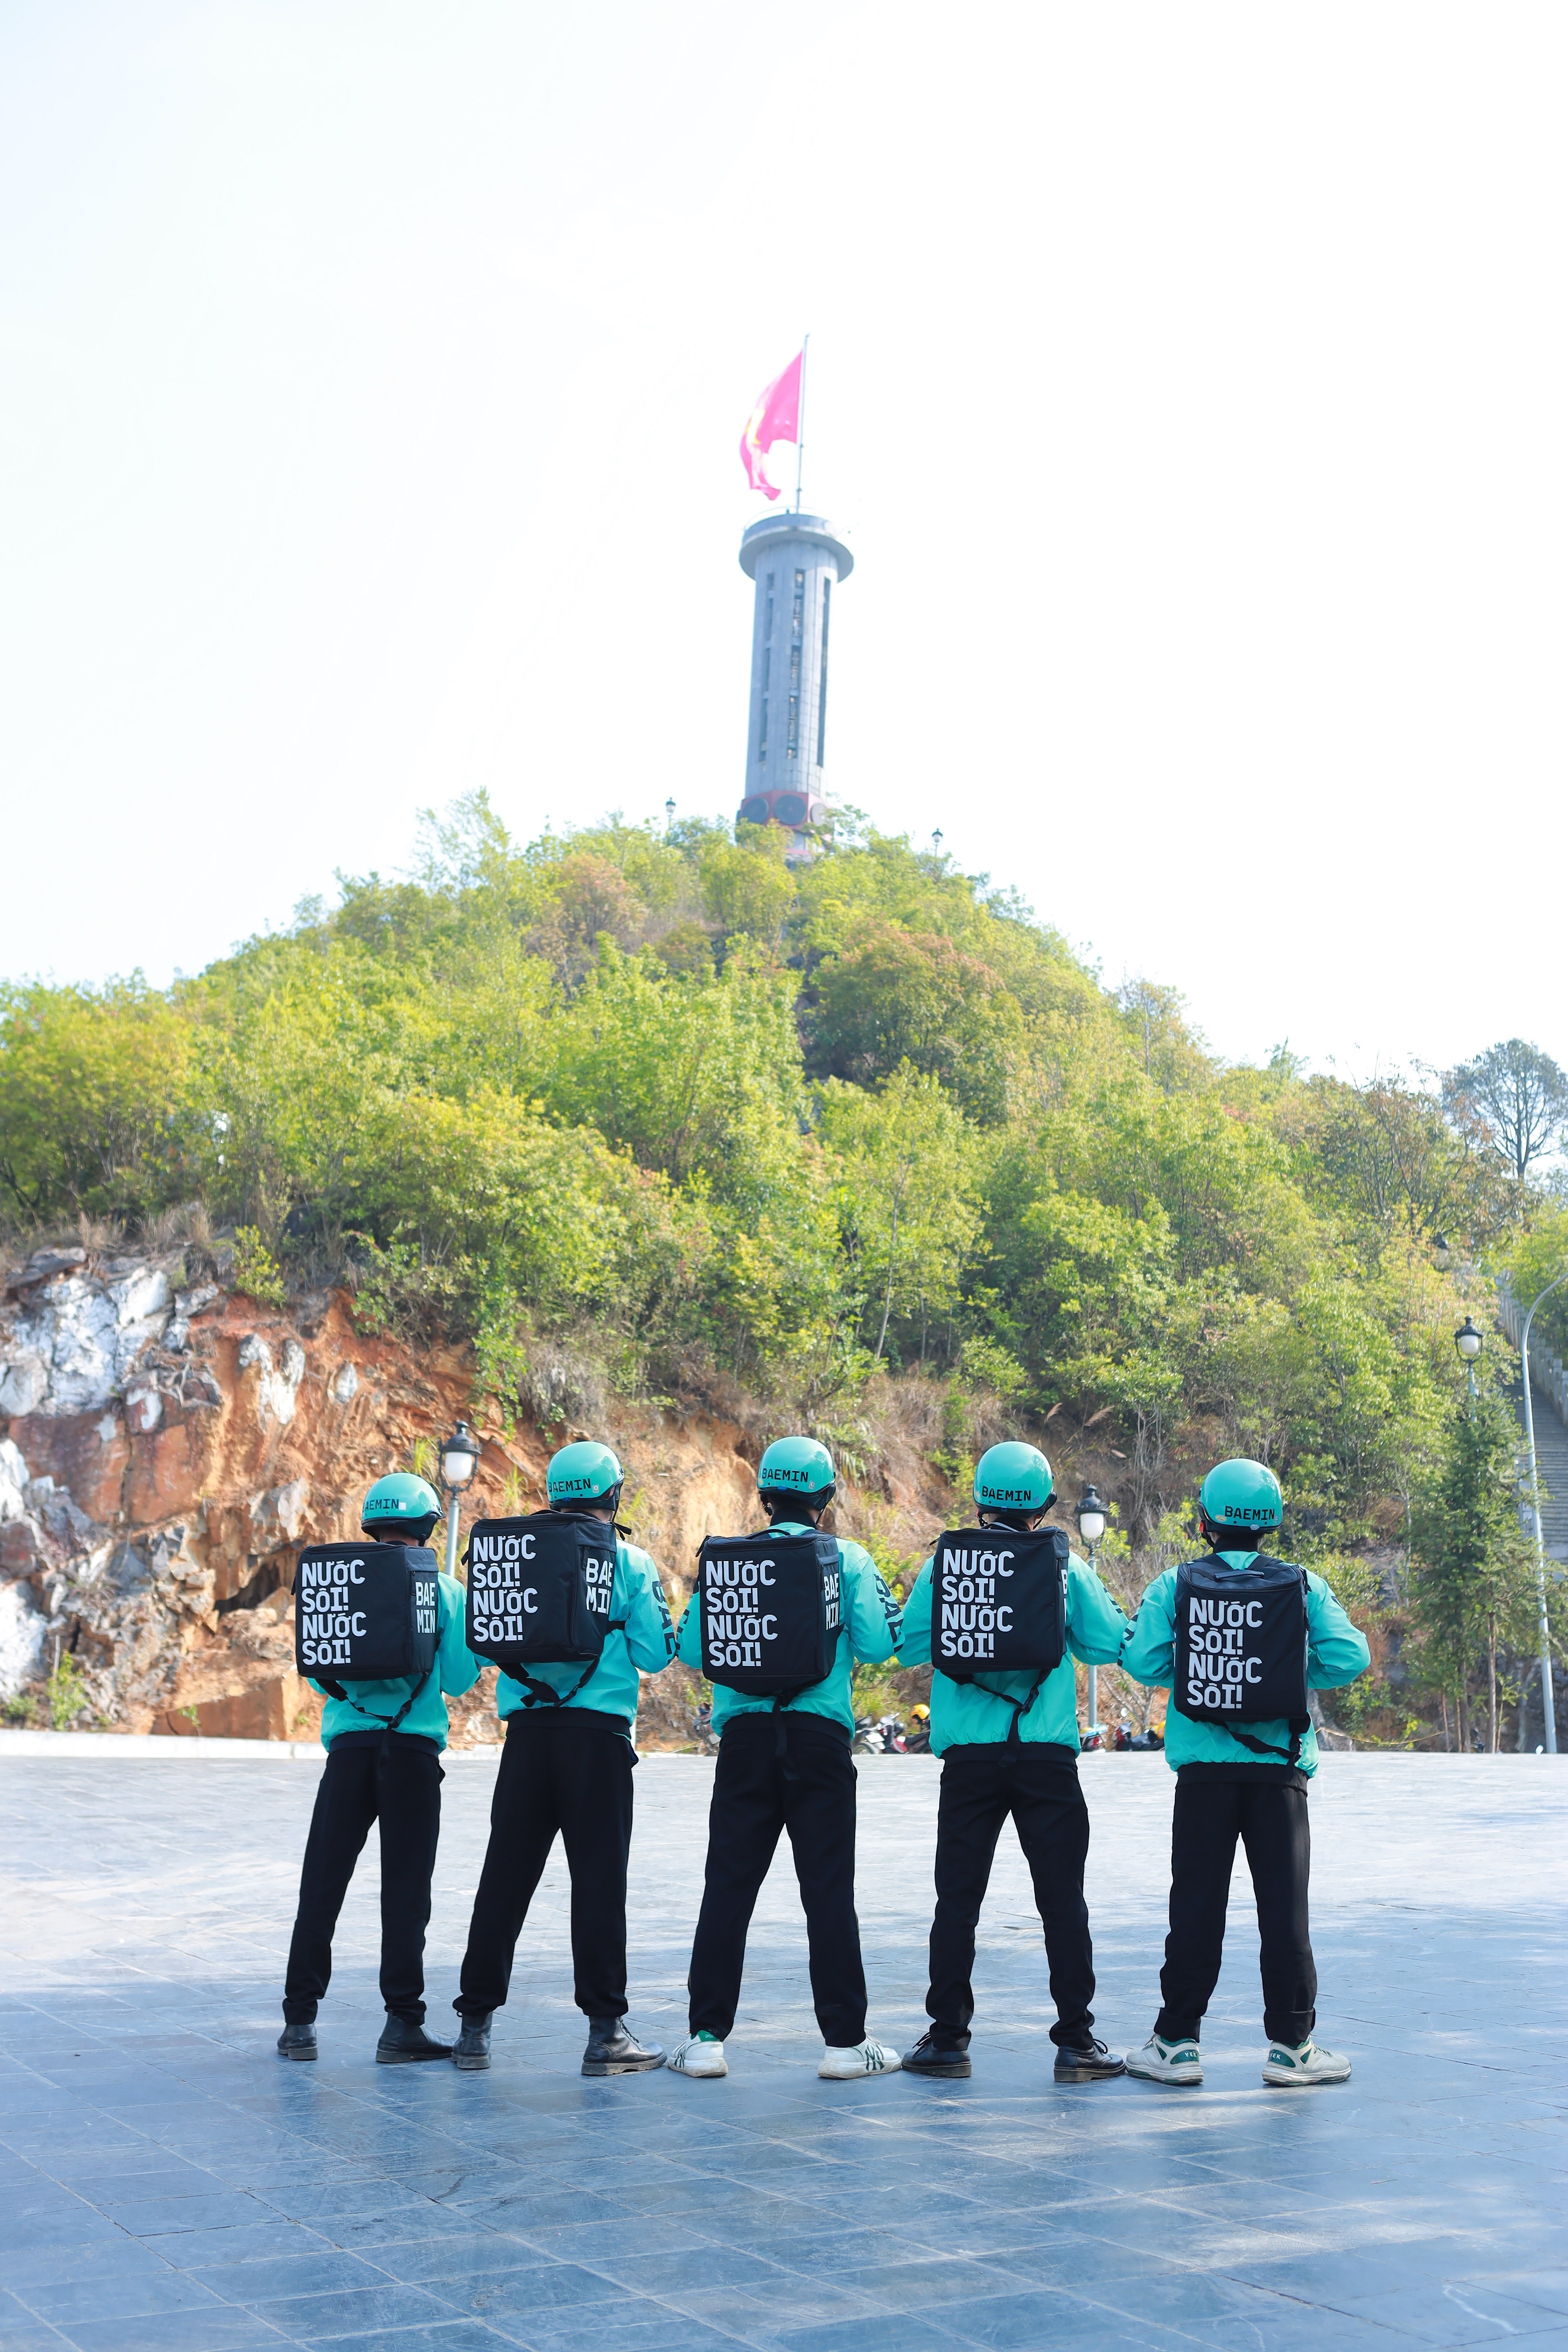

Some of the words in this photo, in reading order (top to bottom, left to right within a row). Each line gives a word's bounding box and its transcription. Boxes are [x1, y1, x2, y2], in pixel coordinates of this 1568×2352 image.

[548, 1478, 592, 1492] BAEMIN
[762, 1468, 808, 1482] BAEMIN
[362, 1498, 400, 1512] AEMIN
[982, 1486, 1031, 1502] BAEMIN
[1224, 1505, 1275, 1520] BAEMIN
[473, 1534, 536, 1562] NƯỚC
[302, 1559, 366, 1588] NƯỚC
[472, 1562, 520, 1588] SÔI!
[586, 1558, 614, 1588] BAE
[706, 1560, 776, 1586] NƯỚC
[942, 1548, 1015, 1578] NƯỚC
[302, 1586, 349, 1613] SÔI!
[415, 1582, 436, 1606] BAE
[586, 1585, 611, 1615] MIN
[706, 1587, 759, 1613] SÔI!
[824, 1572, 839, 1602] BAE
[942, 1576, 995, 1604] SÔI!
[473, 1588, 538, 1616] NƯỚC
[826, 1600, 839, 1630] MIN
[1189, 1596, 1264, 1628] NƯỚC
[302, 1612, 367, 1640] NƯỚC
[416, 1609, 436, 1634] MIN
[473, 1616, 524, 1642] SÔI!
[707, 1614, 778, 1640] NƯỚC
[942, 1604, 1014, 1632] NƯỚC
[302, 1639, 351, 1666] SÔI!
[708, 1641, 762, 1667] SÔI!
[940, 1630, 994, 1658] SÔI!
[1188, 1624, 1244, 1656] SÔI!
[1188, 1652, 1263, 1684] NƯỚC
[1186, 1679, 1243, 1710] SÔI!
